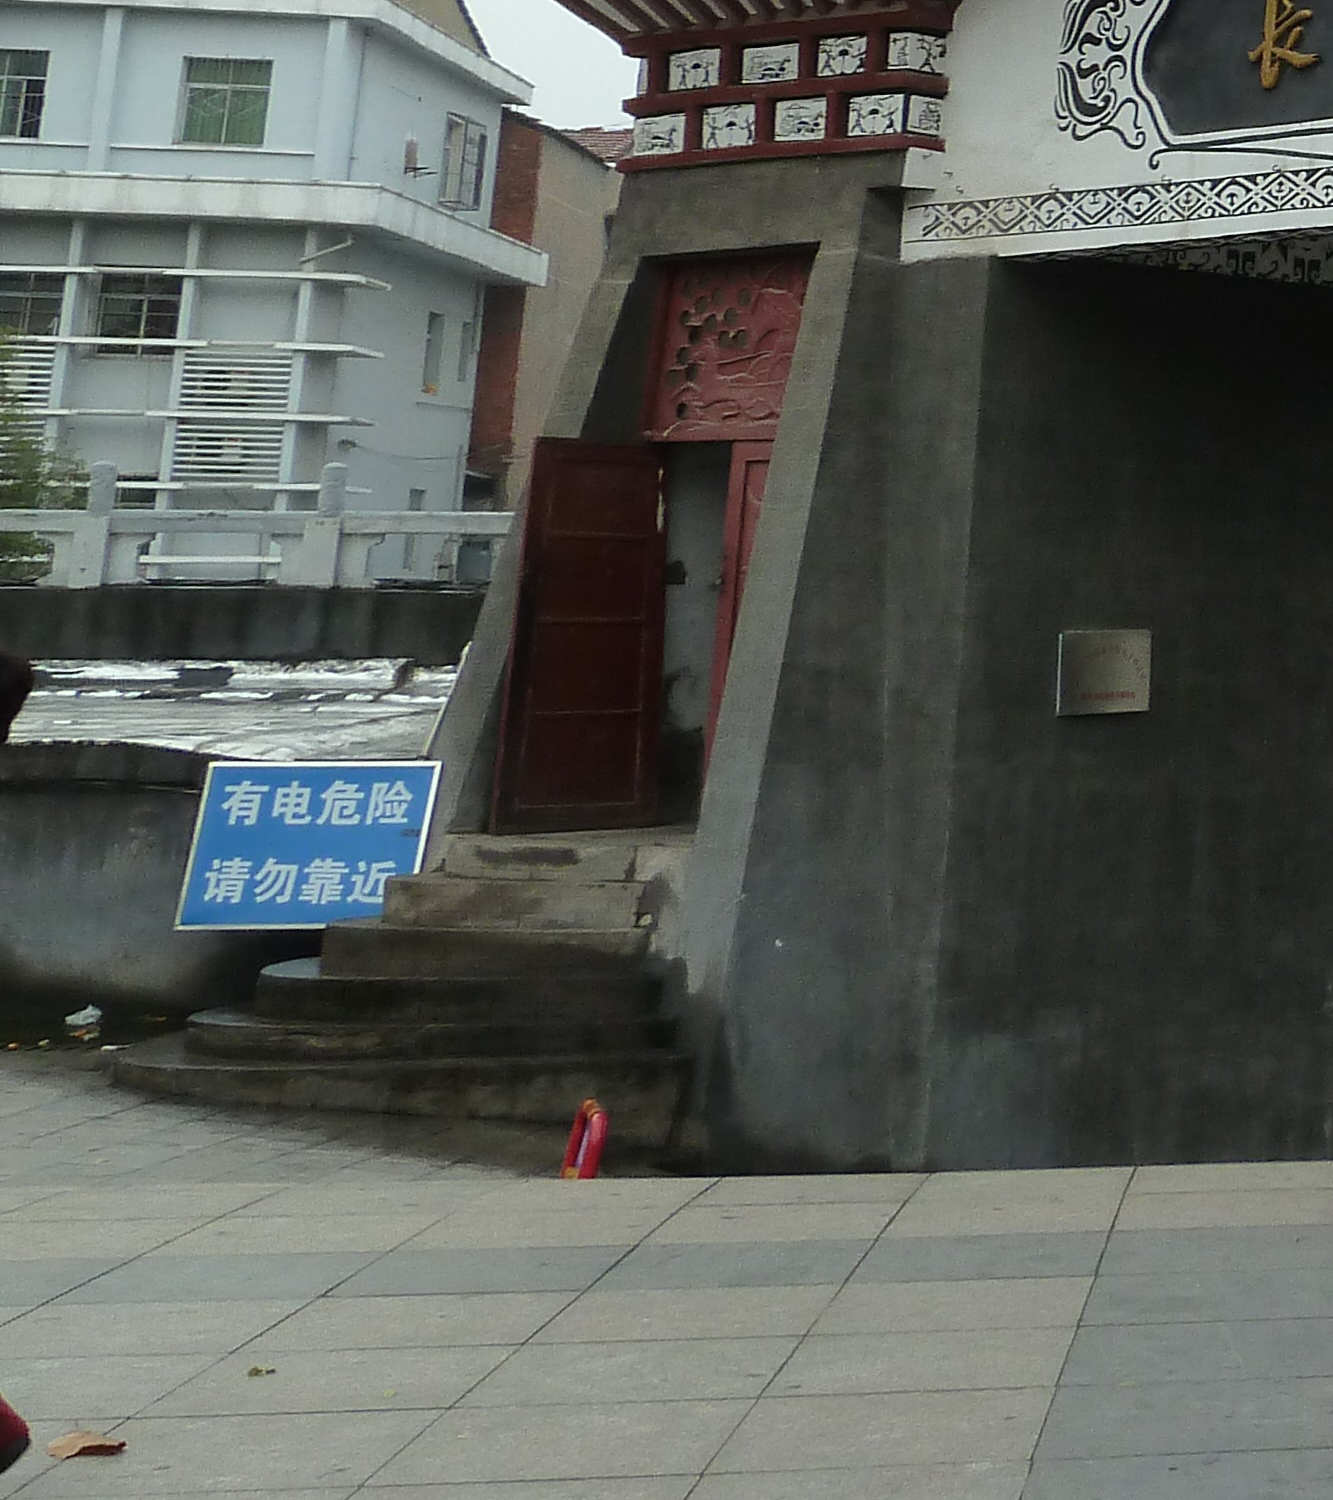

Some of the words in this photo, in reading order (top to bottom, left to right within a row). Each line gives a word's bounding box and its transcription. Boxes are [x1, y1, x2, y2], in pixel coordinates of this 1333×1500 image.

[221, 780, 414, 826] 有电危险
[203, 857, 397, 904] 请勿靠近
